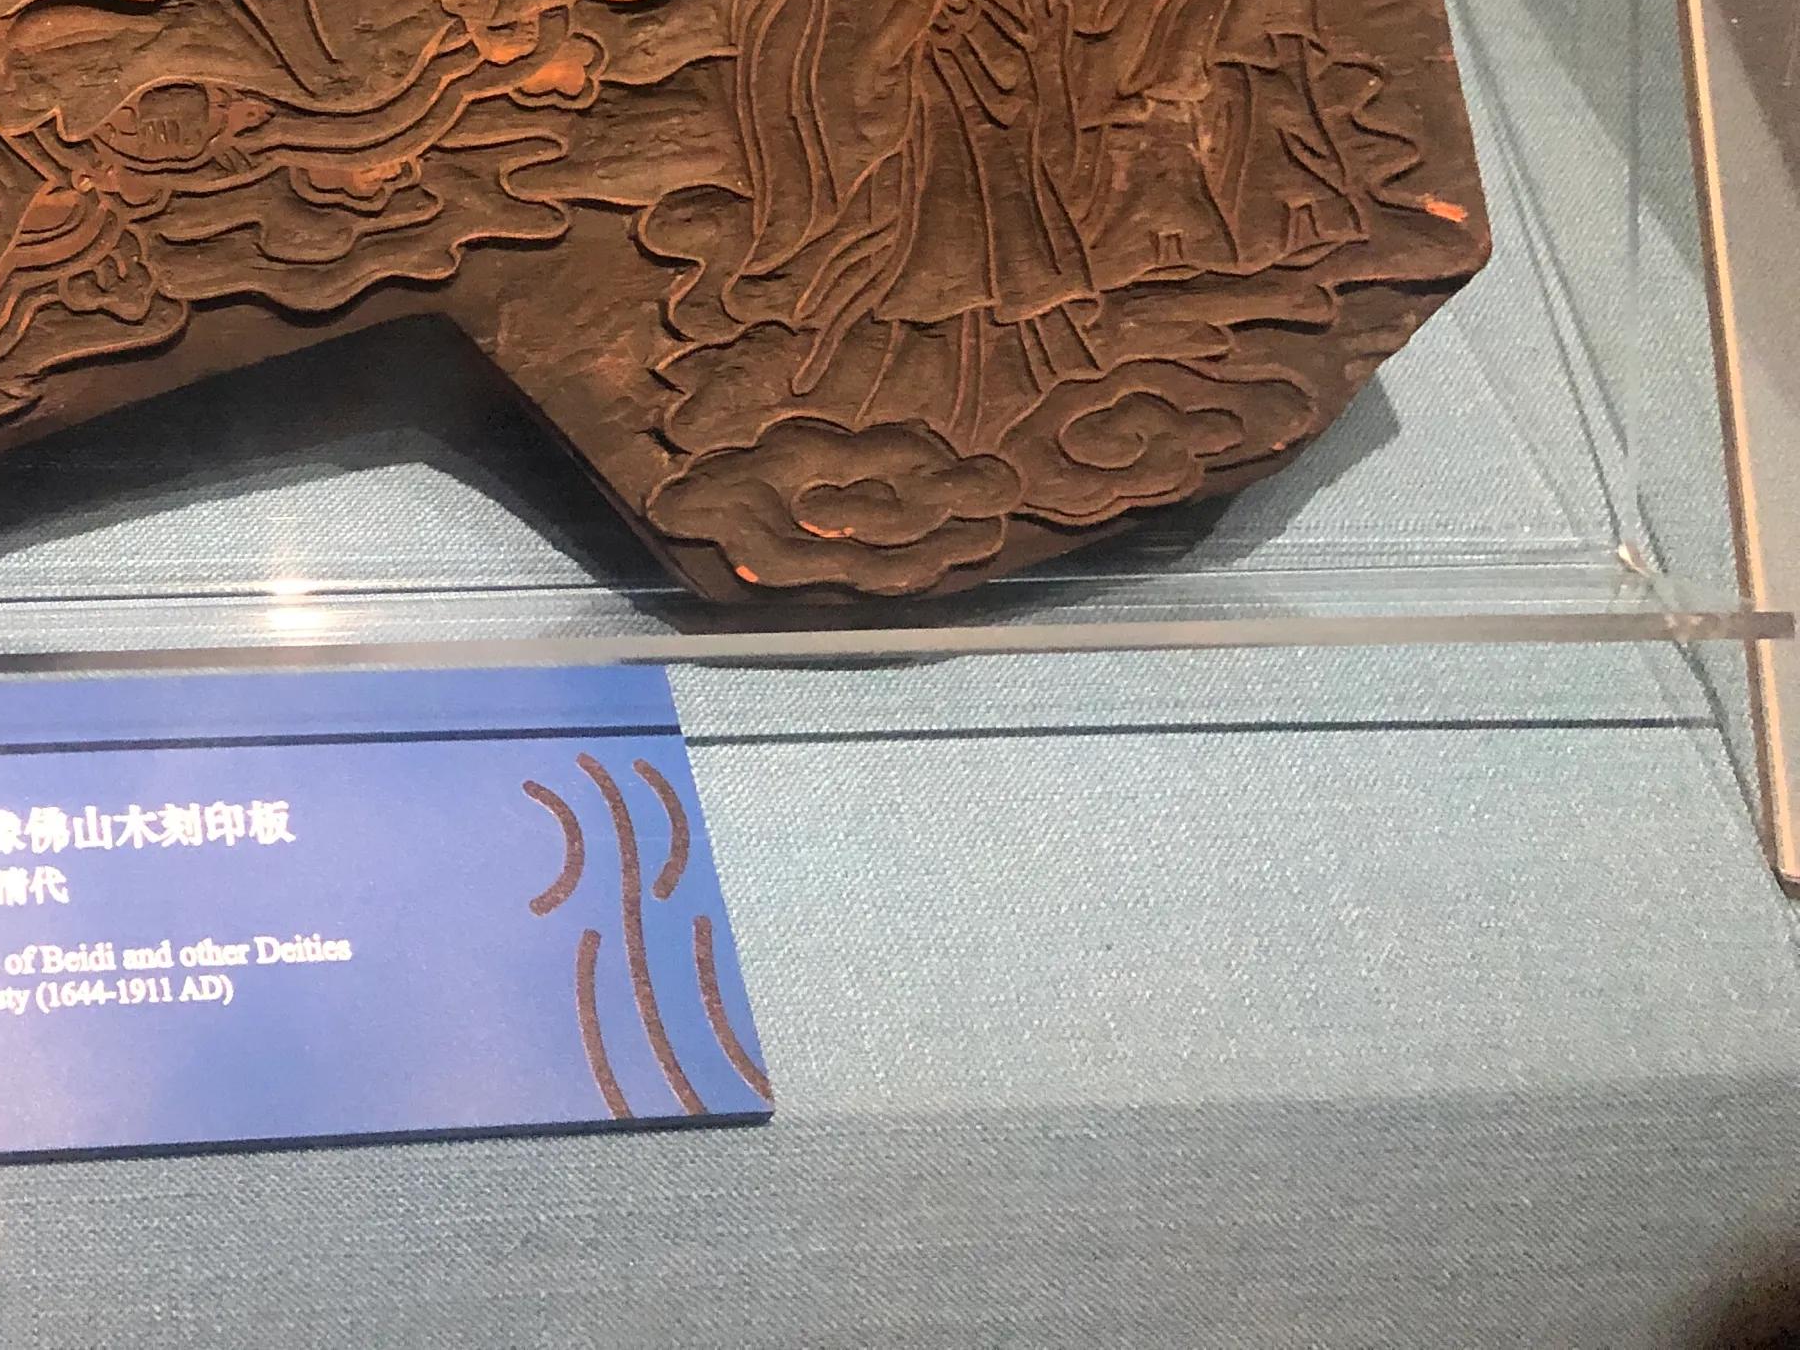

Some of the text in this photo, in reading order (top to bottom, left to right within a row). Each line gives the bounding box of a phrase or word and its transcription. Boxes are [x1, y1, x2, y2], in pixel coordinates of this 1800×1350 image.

[5, 945, 35, 976] of
[41, 942, 115, 972] Beidi
[122, 941, 174, 971] and
[179, 937, 250, 967] other
[255, 932, 352, 965] Deities
[36, 976, 175, 1012] (1644-1911
[179, 975, 234, 1005] AD)
